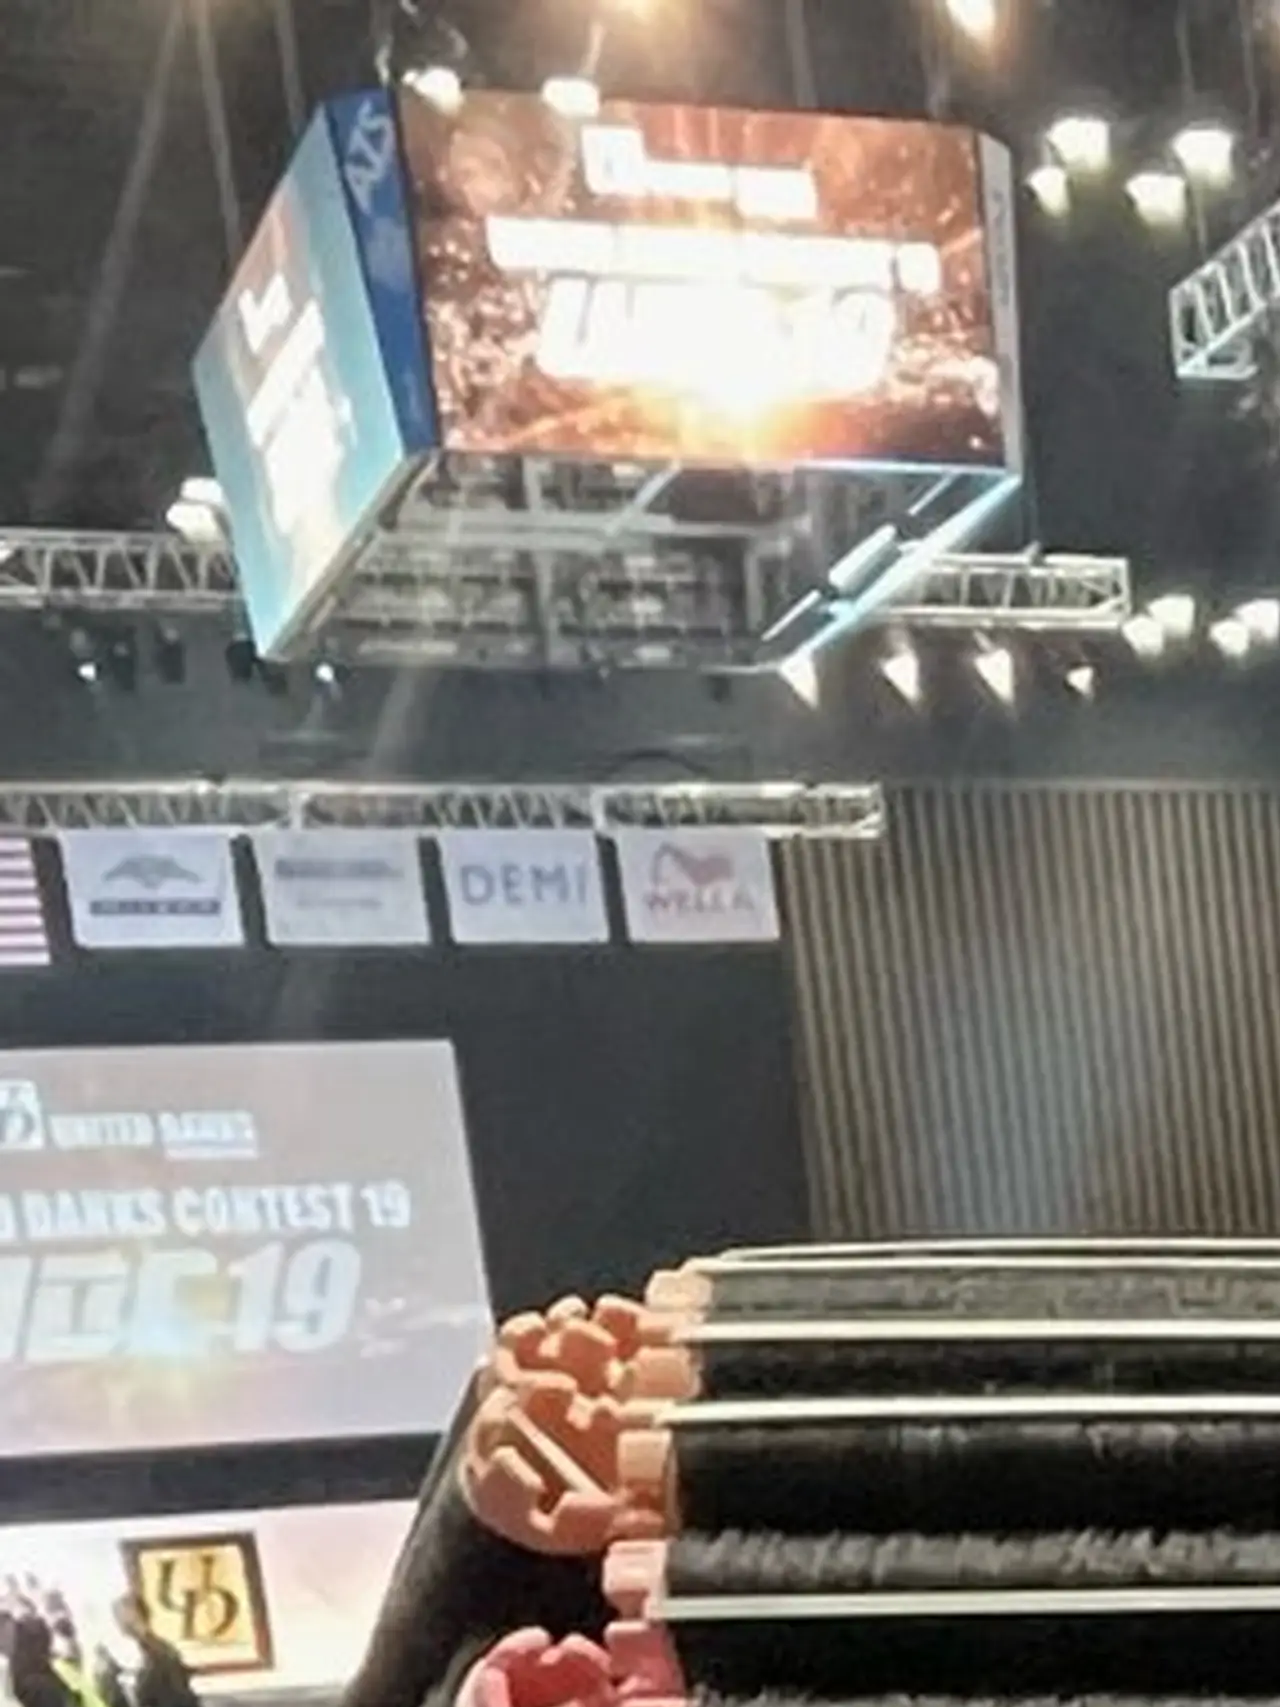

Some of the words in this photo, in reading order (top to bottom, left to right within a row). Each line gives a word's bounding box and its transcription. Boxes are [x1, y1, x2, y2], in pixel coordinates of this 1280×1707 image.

[459, 863, 588, 906] DEMI
[172, 1180, 354, 1238] CONTEST
[361, 1178, 411, 1228] 19
